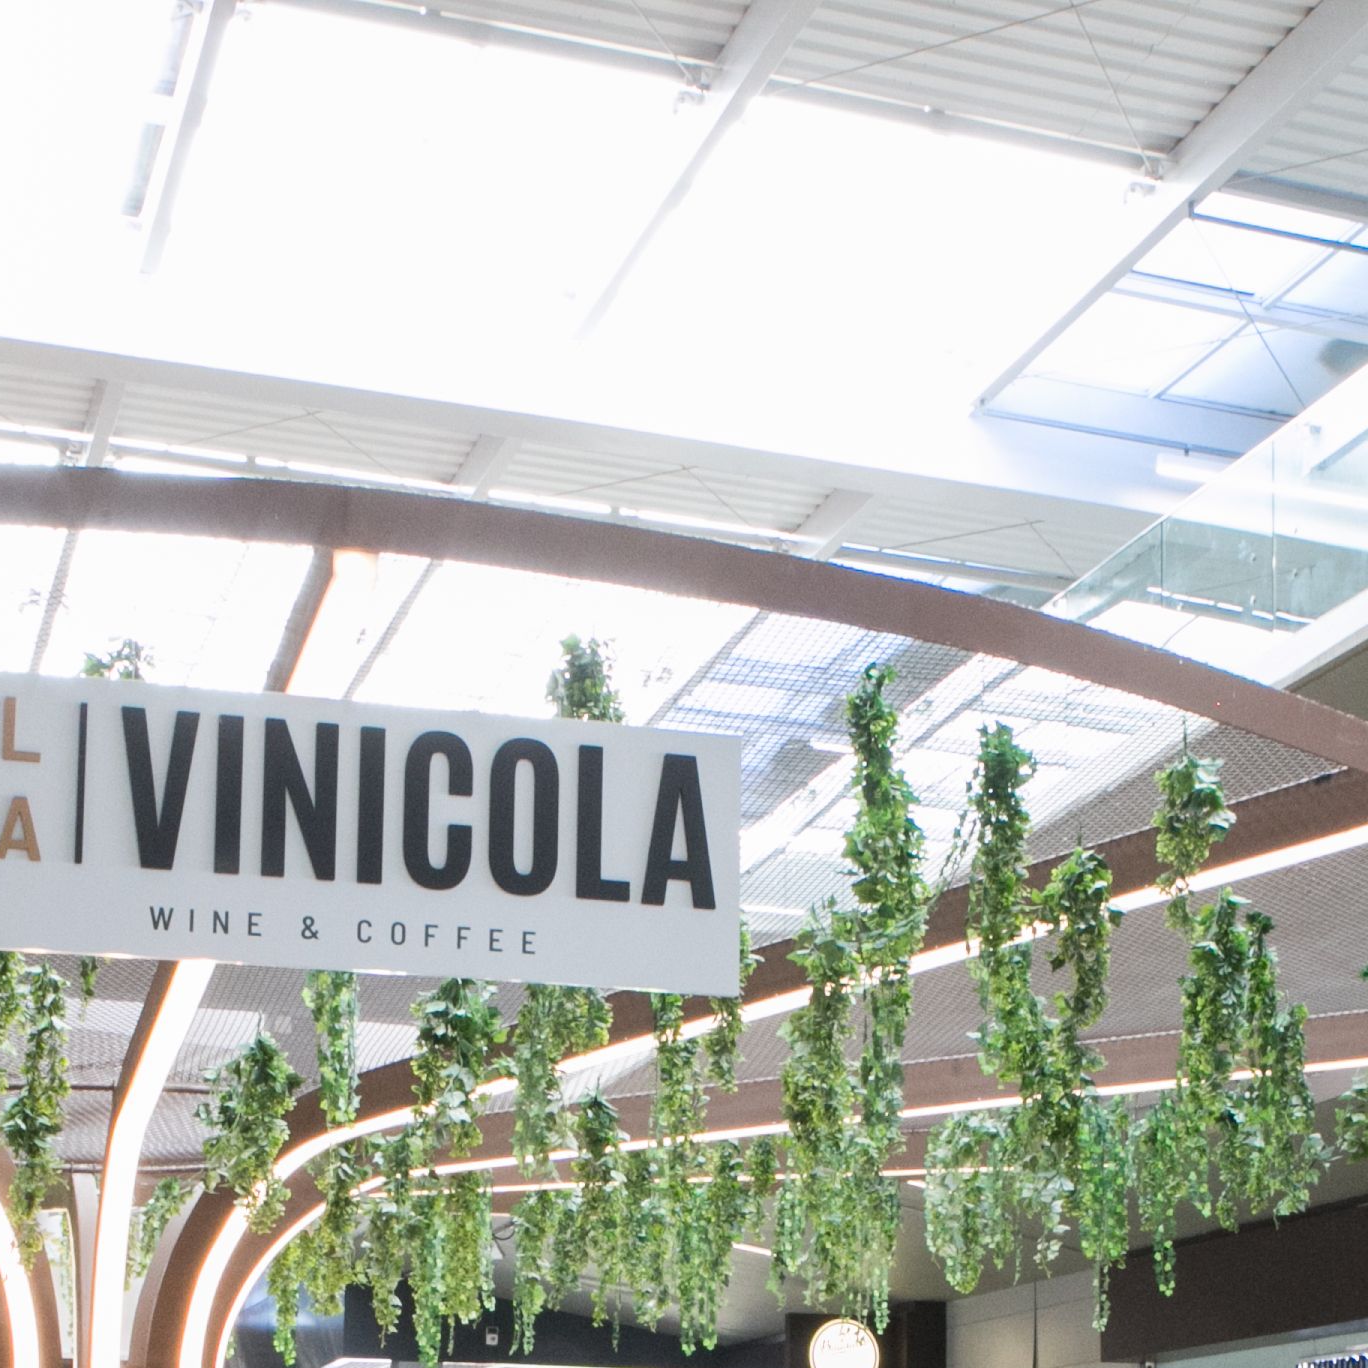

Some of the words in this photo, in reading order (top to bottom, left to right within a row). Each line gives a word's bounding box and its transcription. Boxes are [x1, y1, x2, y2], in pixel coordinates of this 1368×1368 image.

[121, 705, 717, 910] VINICOLA
[149, 905, 263, 937] WINE
[301, 915, 319, 940] &
[356, 919, 537, 954] COFFEE
